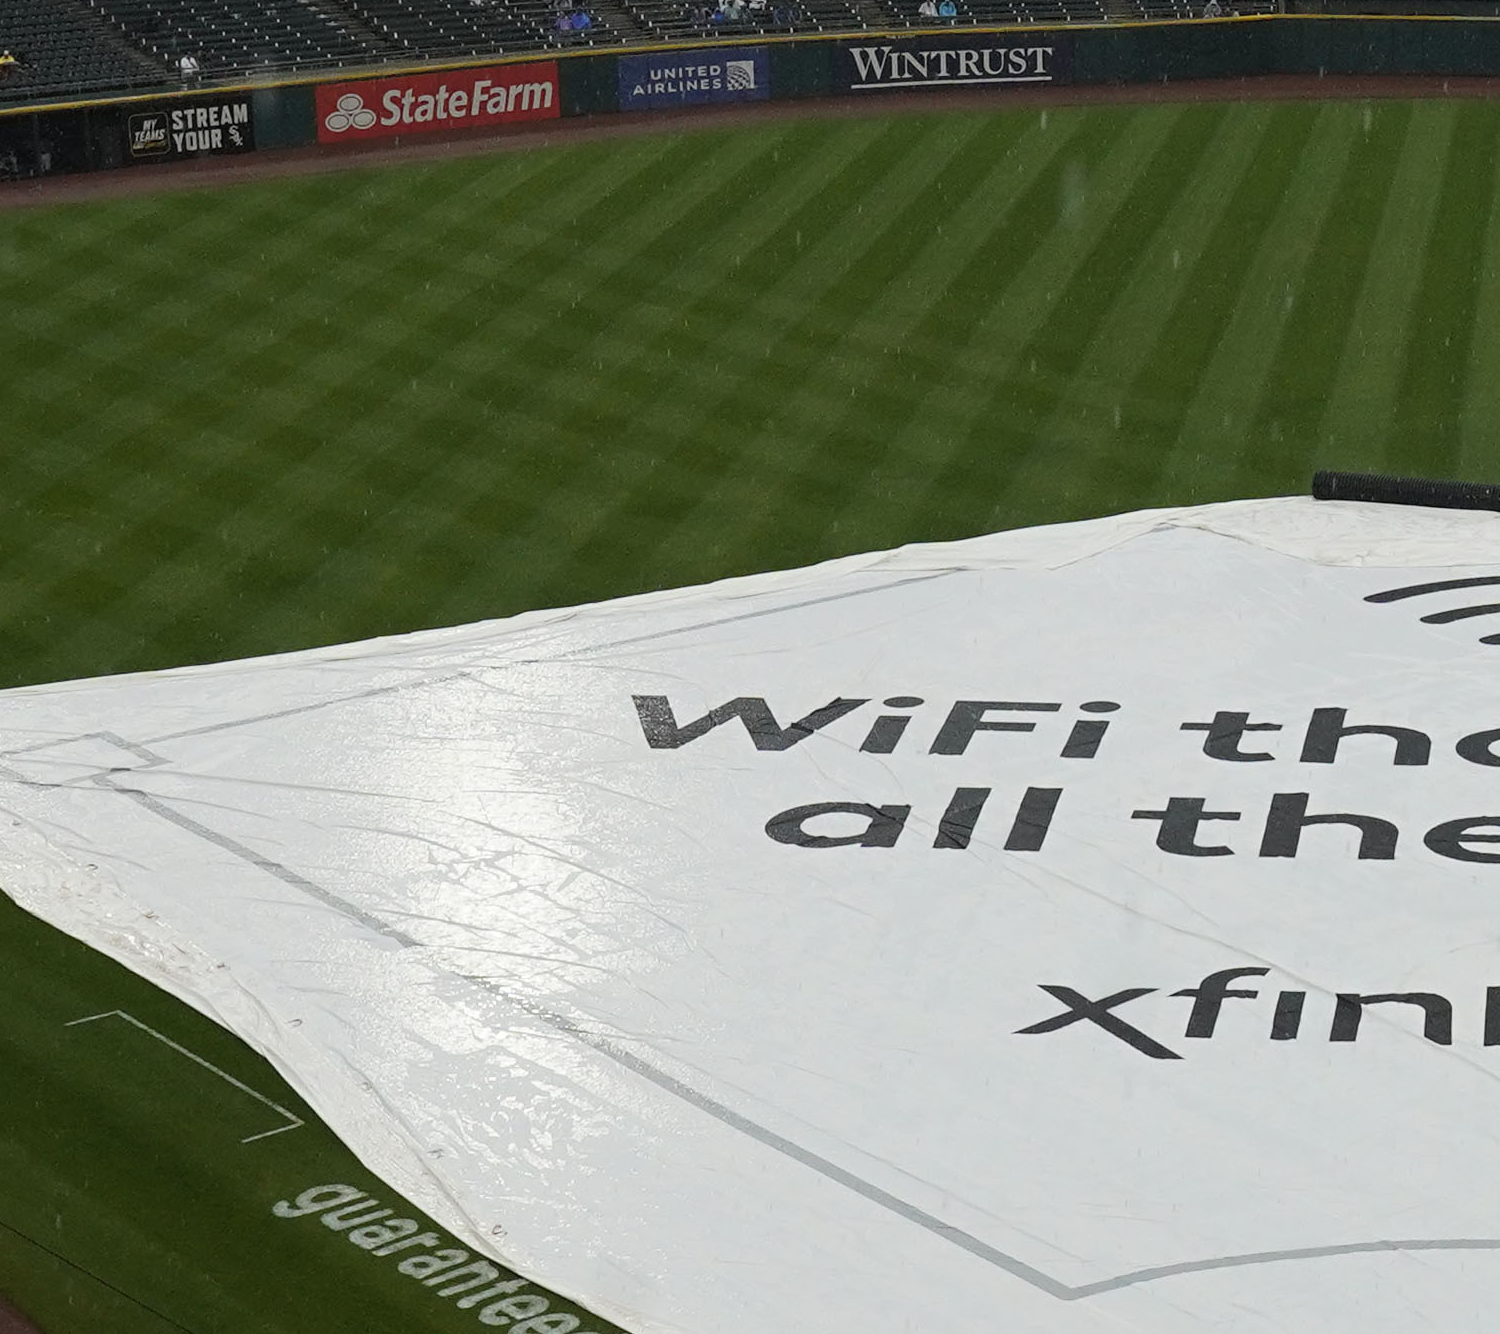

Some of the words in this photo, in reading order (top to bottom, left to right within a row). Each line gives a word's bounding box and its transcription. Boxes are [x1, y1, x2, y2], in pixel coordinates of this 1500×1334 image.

[649, 62, 722, 84] UNITED
[850, 45, 1054, 83] WINTRUST
[632, 76, 722, 97] AIRLINES
[171, 103, 249, 132] STREAM
[172, 126, 223, 154] YOUR
[631, 693, 1123, 761] WiFi
[764, 786, 1062, 854] all
